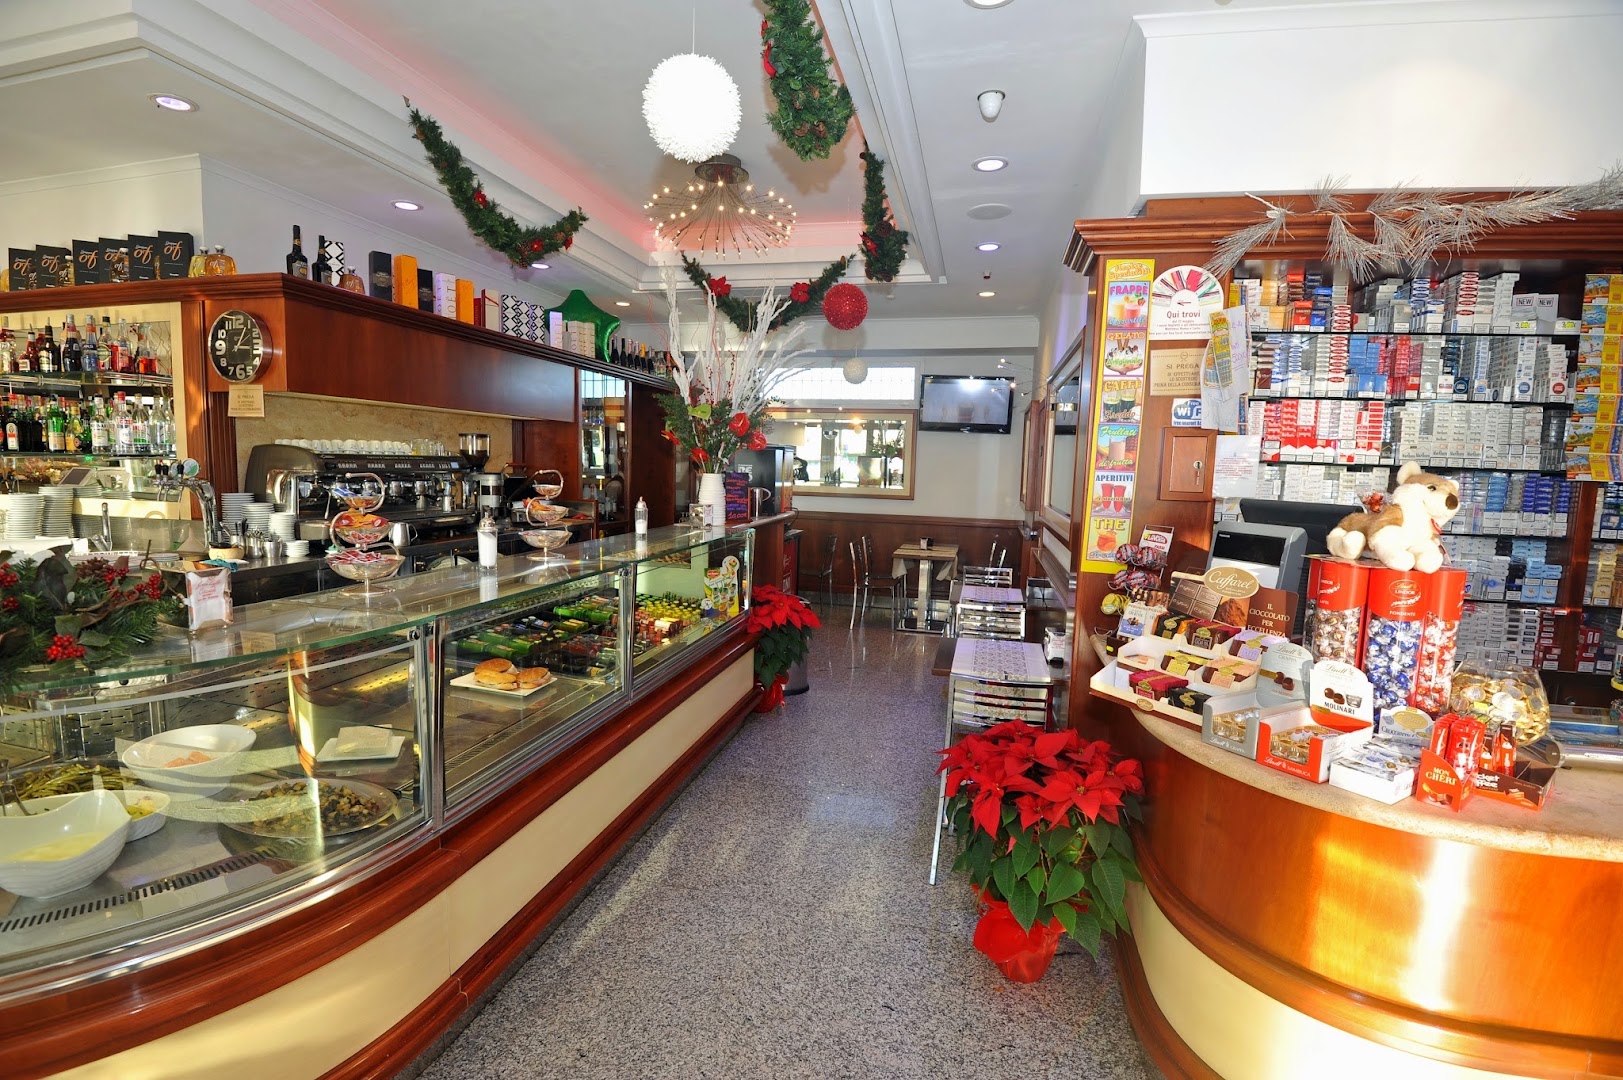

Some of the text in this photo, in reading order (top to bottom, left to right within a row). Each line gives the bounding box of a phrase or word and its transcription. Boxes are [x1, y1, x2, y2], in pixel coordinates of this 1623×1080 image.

[1110, 282, 1149, 296] FRAPPÈ
[1166, 310, 1201, 319] Qui trovi
[232, 314, 245, 329] 12
[218, 329, 227, 339] 10
[252, 328, 260, 338] 2
[1106, 332, 1146, 341] GELATO
[214, 340, 227, 356] 9
[252, 339, 264, 355] 3
[220, 358, 227, 367] 8
[252, 356, 260, 366] 4
[228, 366, 235, 376] 7
[236, 364, 246, 380] 6
[246, 366, 253, 376] 5
[1104, 378, 1142, 393] CAFFÈ
[1100, 426, 1137, 438] Frullati
[1098, 458, 1134, 469] di frutta
[1095, 474, 1134, 483] APERITIVI
[1094, 518, 1127, 531] THE
[1208, 570, 1255, 590] Caffarel
[1249, 608, 1291, 622] CIOCCOLATO
[1262, 620, 1274, 628] PER
[1247, 624, 1287, 638] ECCELLENZA
[1278, 644, 1297, 655] Lindt
[1324, 662, 1348, 675] Lindt
[1324, 701, 1355, 716] MOLINARI
[1209, 736, 1225, 746] Lindt
[1264, 756, 1283, 767] Lindt
[1433, 766, 1451, 777] MON
[1425, 771, 1457, 786] CHERI
